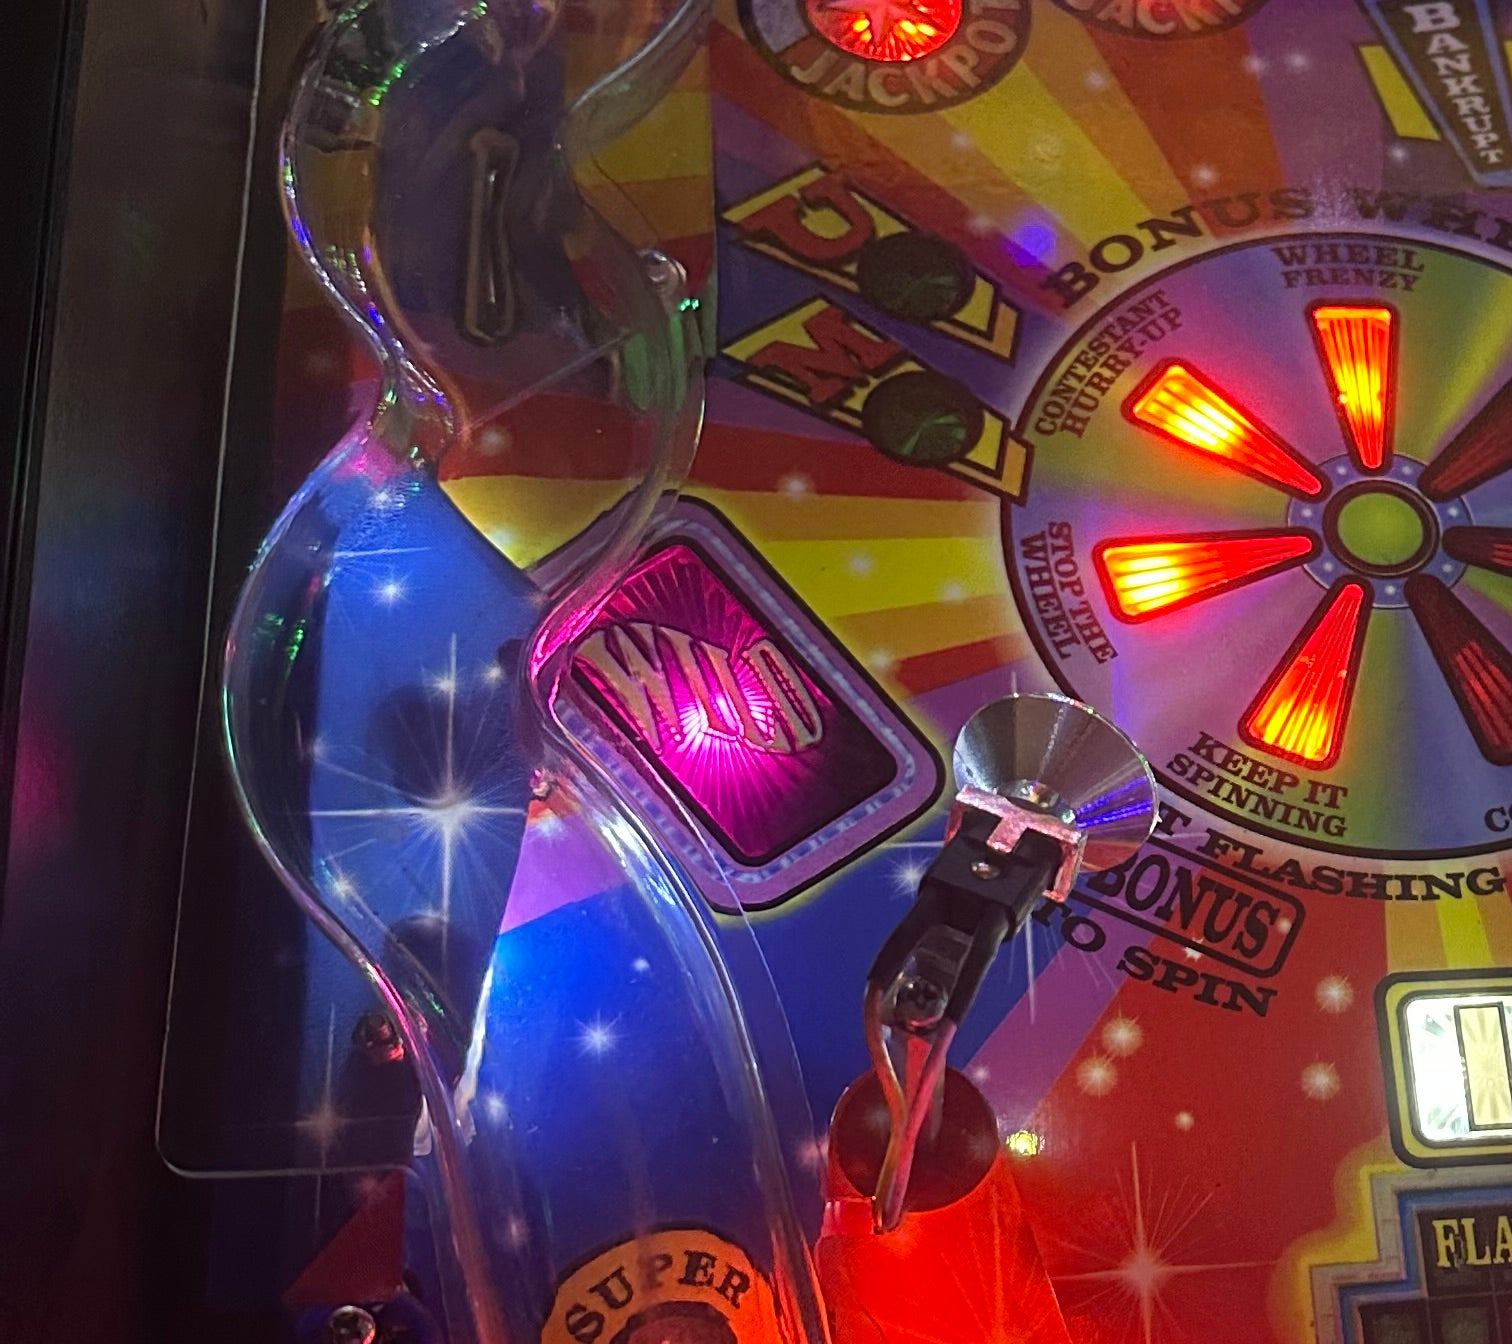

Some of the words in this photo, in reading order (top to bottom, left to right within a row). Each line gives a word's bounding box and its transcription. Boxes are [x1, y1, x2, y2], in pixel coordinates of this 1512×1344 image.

[1403, 0, 1503, 165] BANKRUPT
[1042, 187, 1320, 310] BONUS
[1270, 243, 1426, 275] WHEEL
[1282, 267, 1420, 294] FRENZY
[748, 305, 902, 402] M
[1035, 287, 1172, 437] CONTESTANT
[1061, 305, 1186, 440] HURRY-UP
[1020, 531, 1081, 660] WHEEL
[1046, 520, 1084, 594] STOP
[1068, 598, 1119, 665] THE
[1166, 752, 1350, 840] SPINNING
[1188, 731, 1302, 797] KEEP
[1308, 777, 1350, 811] IT
[1086, 851, 1281, 959] BONUS
[1197, 827, 1508, 904] FLASHING
[1116, 944, 1278, 1018] SPIN
